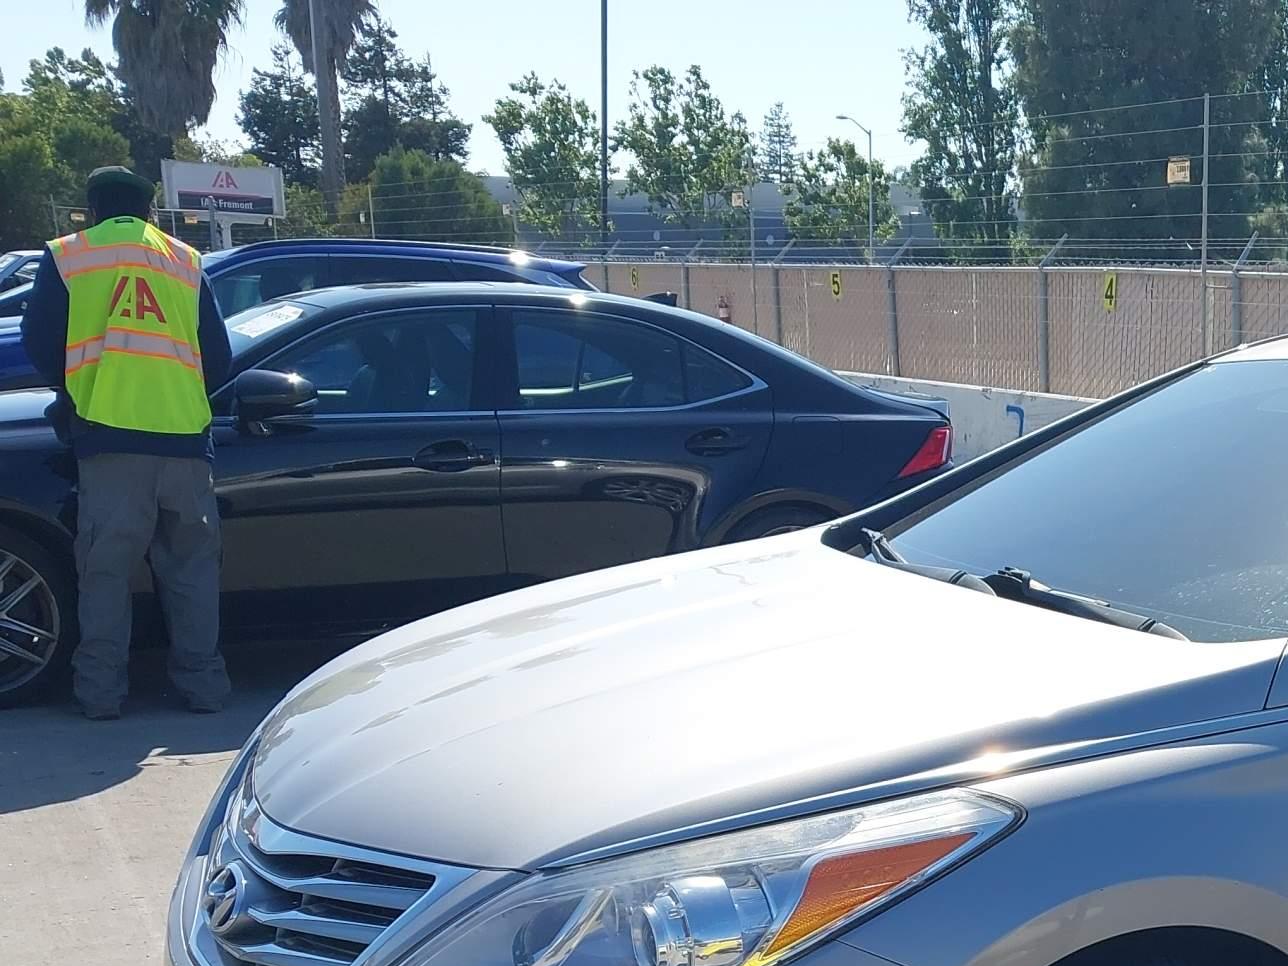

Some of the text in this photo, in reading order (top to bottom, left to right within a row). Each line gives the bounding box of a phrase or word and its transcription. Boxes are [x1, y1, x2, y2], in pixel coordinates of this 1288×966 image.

[219, 199, 254, 210] Fremont
[832, 273, 840, 296] 5
[1104, 277, 1114, 306] 4
